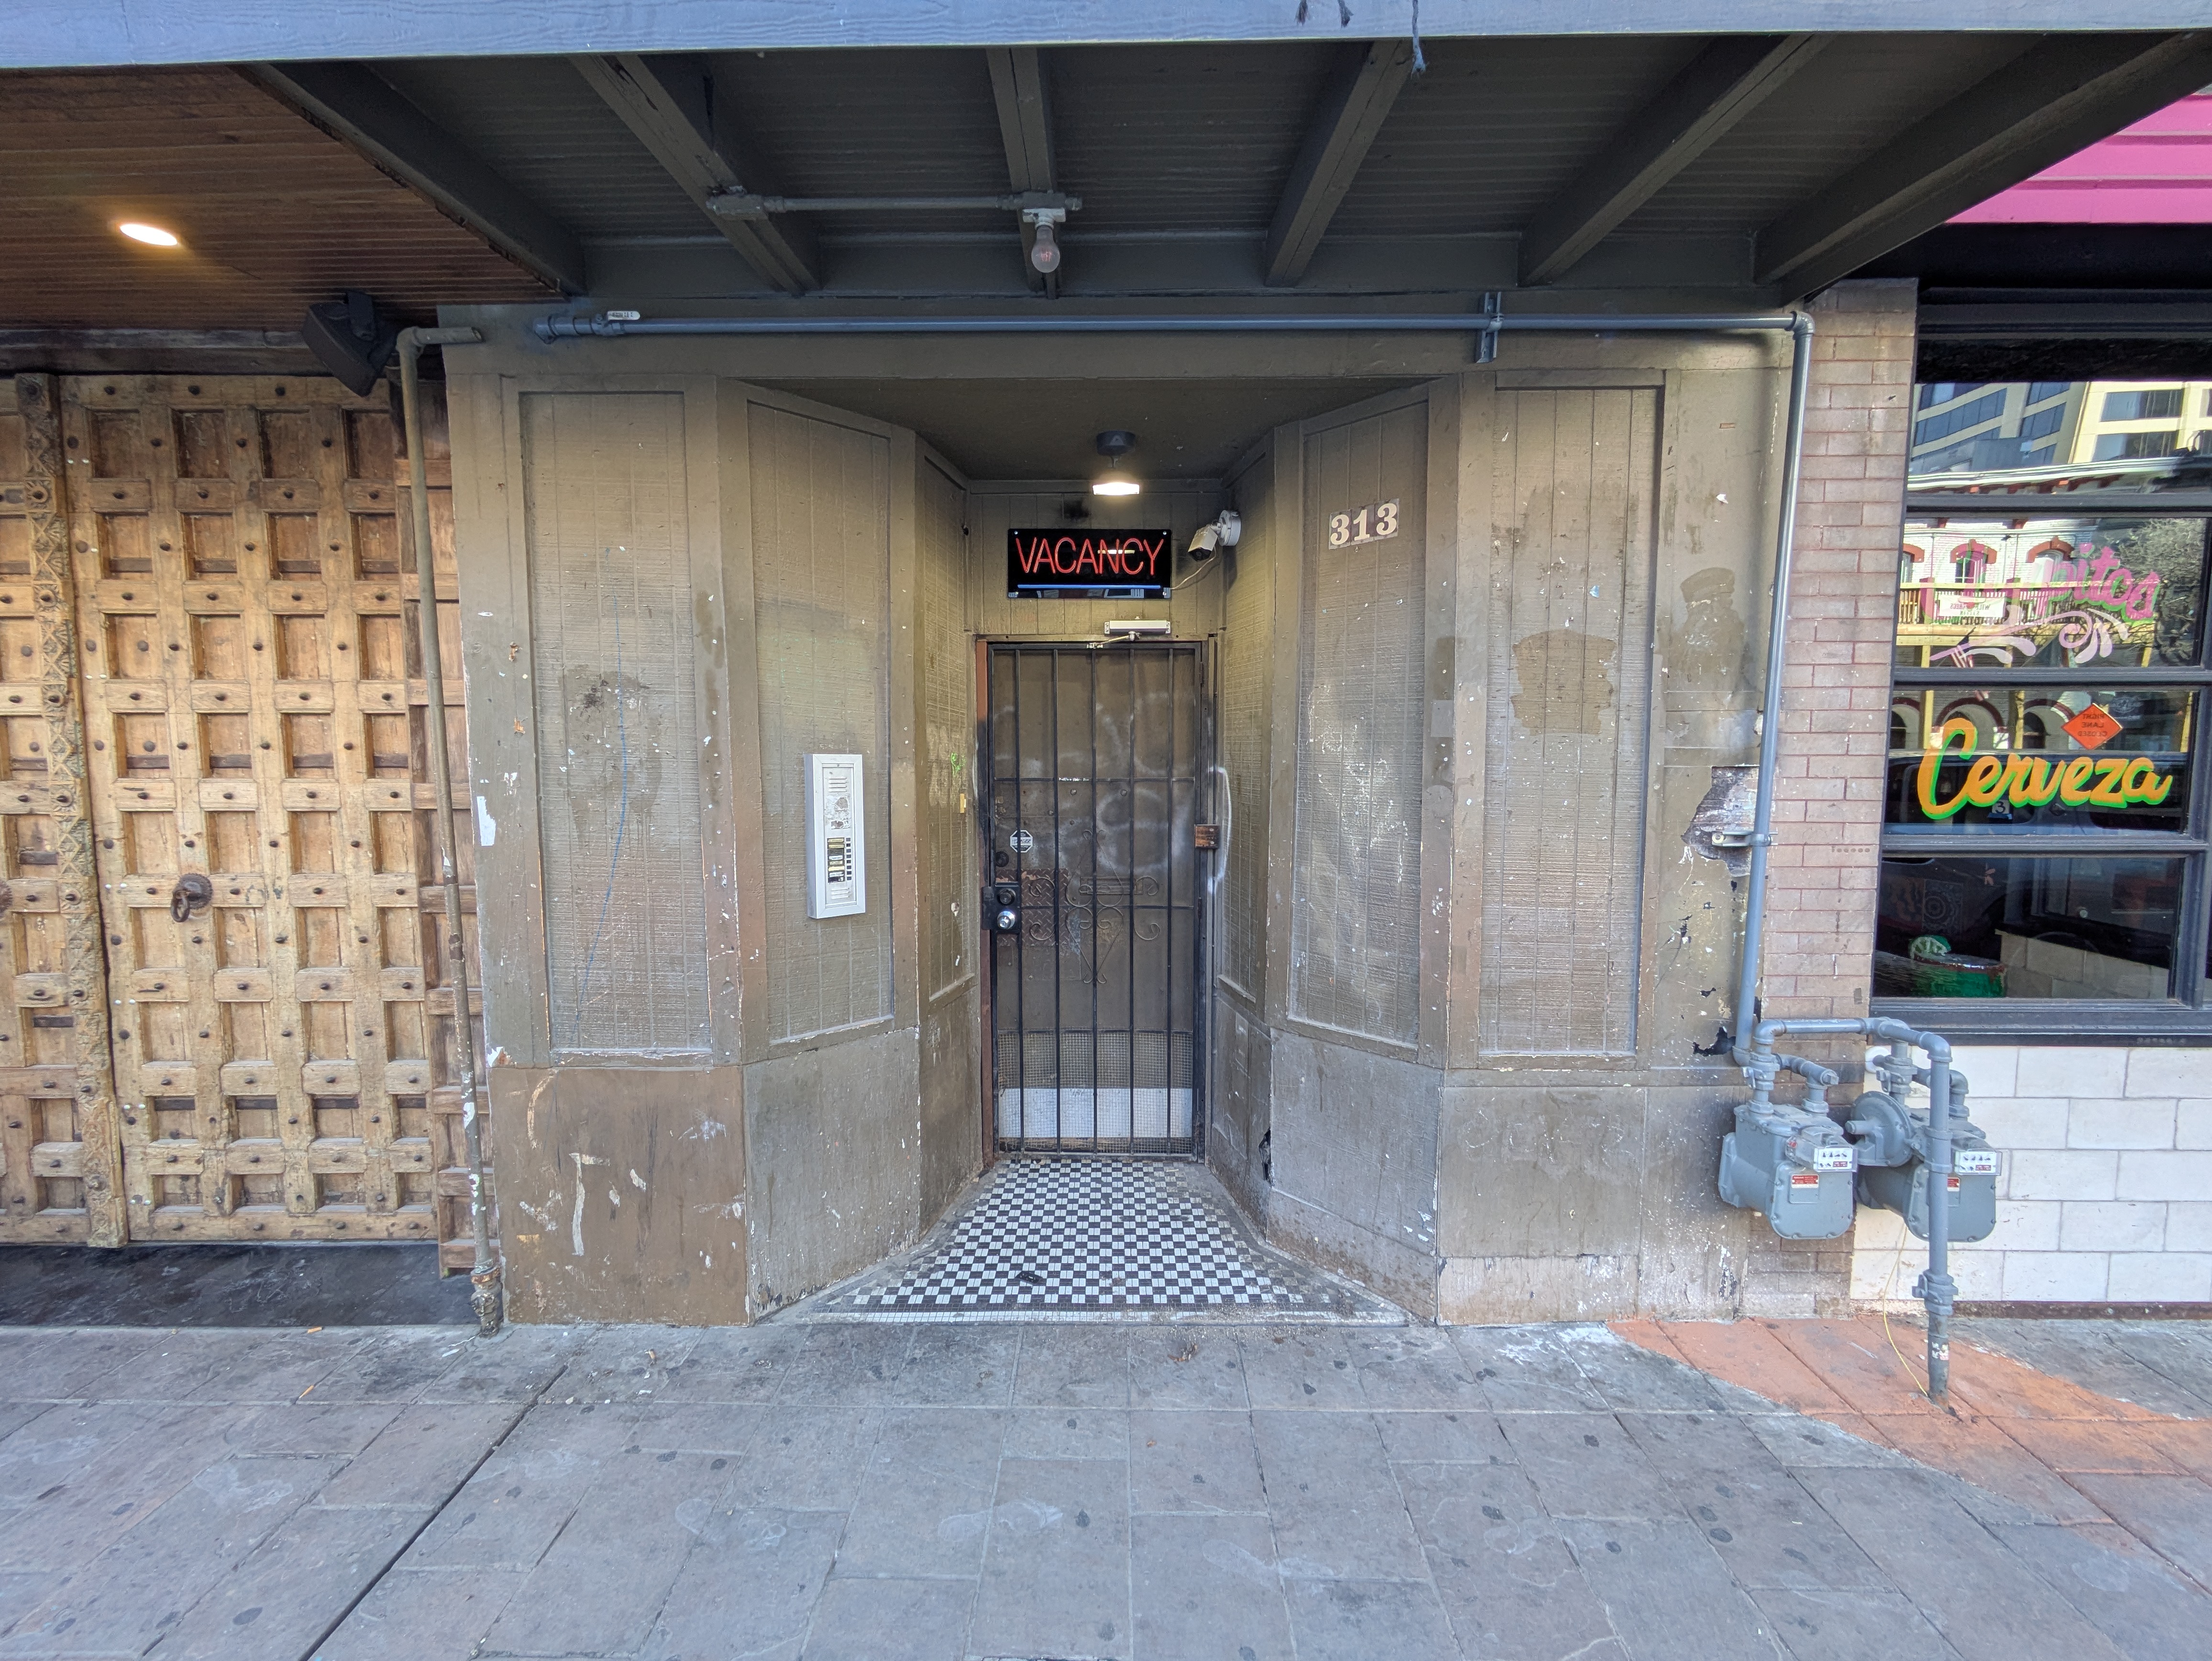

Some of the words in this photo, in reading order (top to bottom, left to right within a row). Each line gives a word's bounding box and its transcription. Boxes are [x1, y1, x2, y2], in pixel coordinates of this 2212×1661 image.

[1330, 503, 1398, 545] 313
[1016, 537, 1164, 576] VACANCY
[1916, 717, 2173, 820] Cerveza
[1995, 801, 2006, 814] 3
